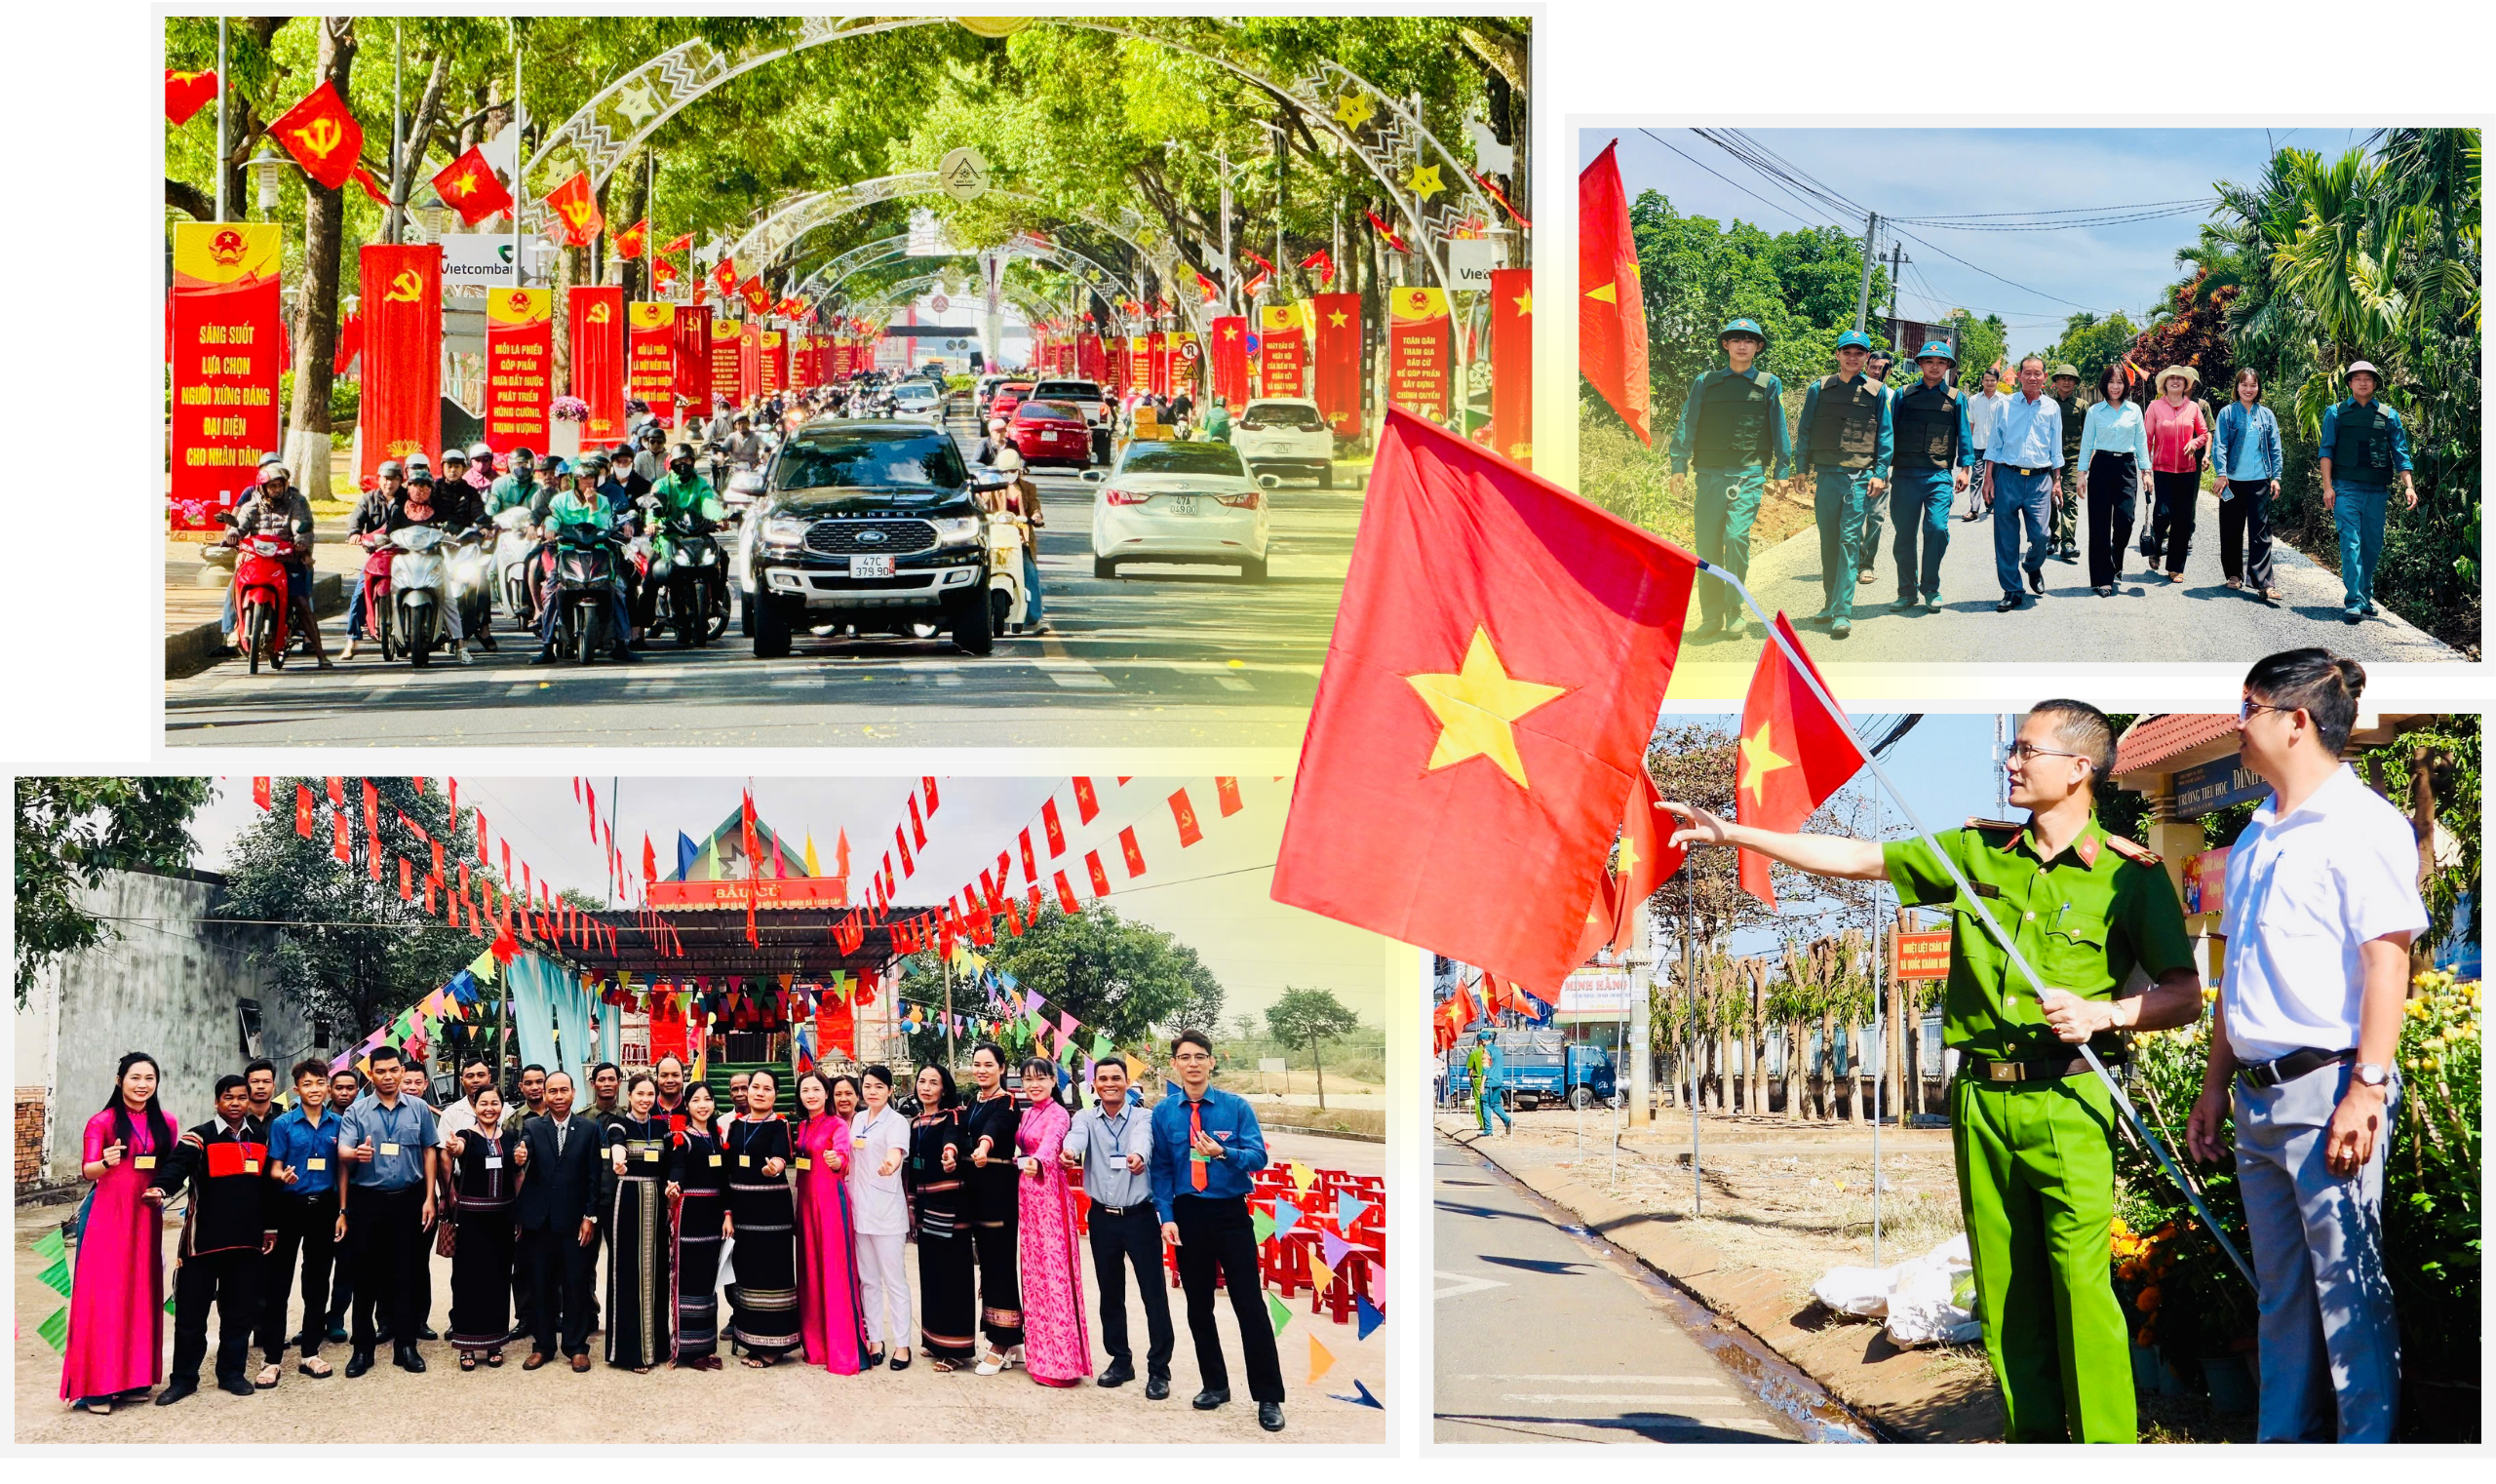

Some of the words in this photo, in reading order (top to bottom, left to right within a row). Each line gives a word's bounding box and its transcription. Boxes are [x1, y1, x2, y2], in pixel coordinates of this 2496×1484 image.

[441, 262, 525, 275] Vietcomba
[199, 322, 226, 344] SÁNG
[229, 320, 254, 344] SUỐT
[201, 355, 221, 378] LỰA
[223, 357, 251, 379] CHỌN
[181, 382, 212, 406] NGƯỜI
[214, 384, 241, 406] XỨNG
[243, 384, 270, 406] ĐÁNG
[204, 417, 220, 440] ĐẠI
[222, 414, 247, 440] DIỆN
[186, 448, 206, 466] CHO
[209, 445, 236, 466] NHÂN
[863, 557, 881, 566] 47C
[2215, 781, 2229, 799] HỌC
